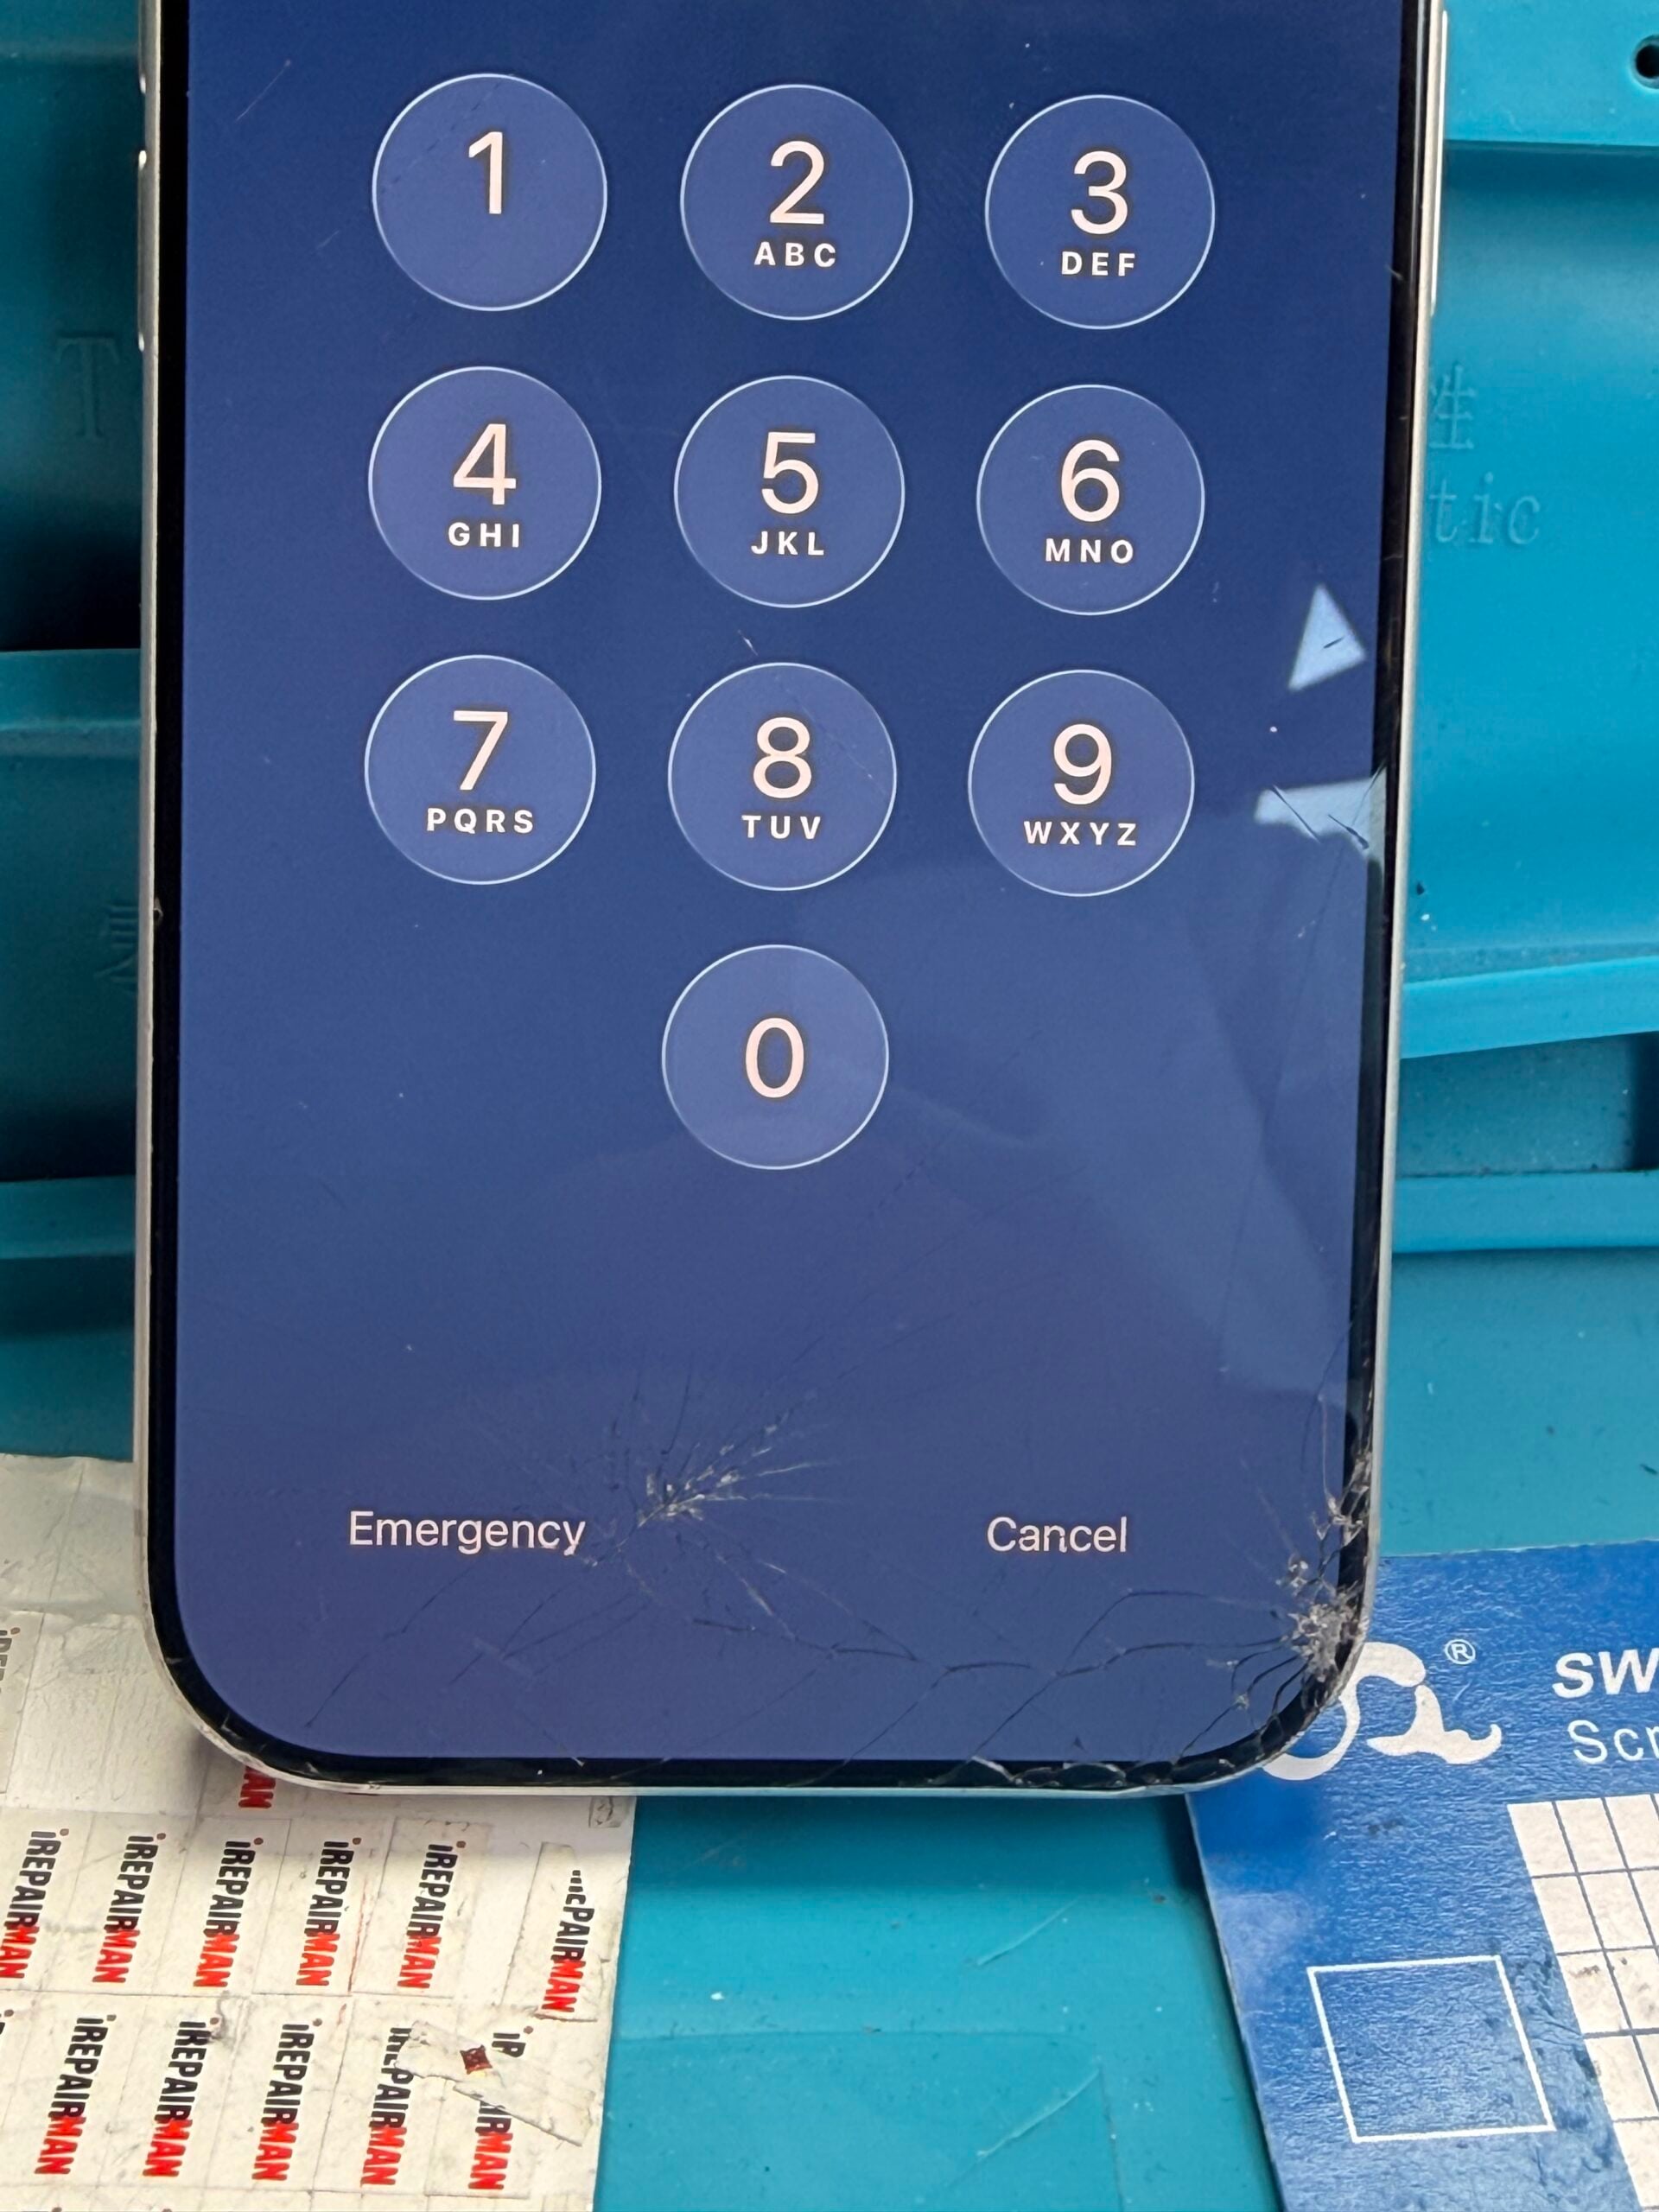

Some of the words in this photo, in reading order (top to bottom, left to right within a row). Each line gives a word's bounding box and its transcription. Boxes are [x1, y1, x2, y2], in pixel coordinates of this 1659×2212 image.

[467, 130, 504, 215] 1
[769, 139, 825, 226] 2
[1070, 149, 1129, 236] 3
[753, 240, 836, 269] ABC
[1060, 250, 1136, 277] DEF
[452, 423, 518, 506] 4
[760, 430, 820, 515] 5
[1059, 438, 1121, 524] 6
[447, 521, 520, 549] GHI
[750, 530, 825, 556] JKL
[1045, 537, 1135, 565] MNO
[452, 709, 509, 791] 7
[752, 715, 813, 800] 8
[1052, 722, 1113, 806] 9
[426, 806, 534, 836] PQRS
[741, 814, 822, 841] TUV
[1022, 820, 1137, 847] WXYZ
[744, 1016, 805, 1099] 0
[349, 1510, 587, 1556] Emergency
[986, 1516, 1128, 1554] Cancel
